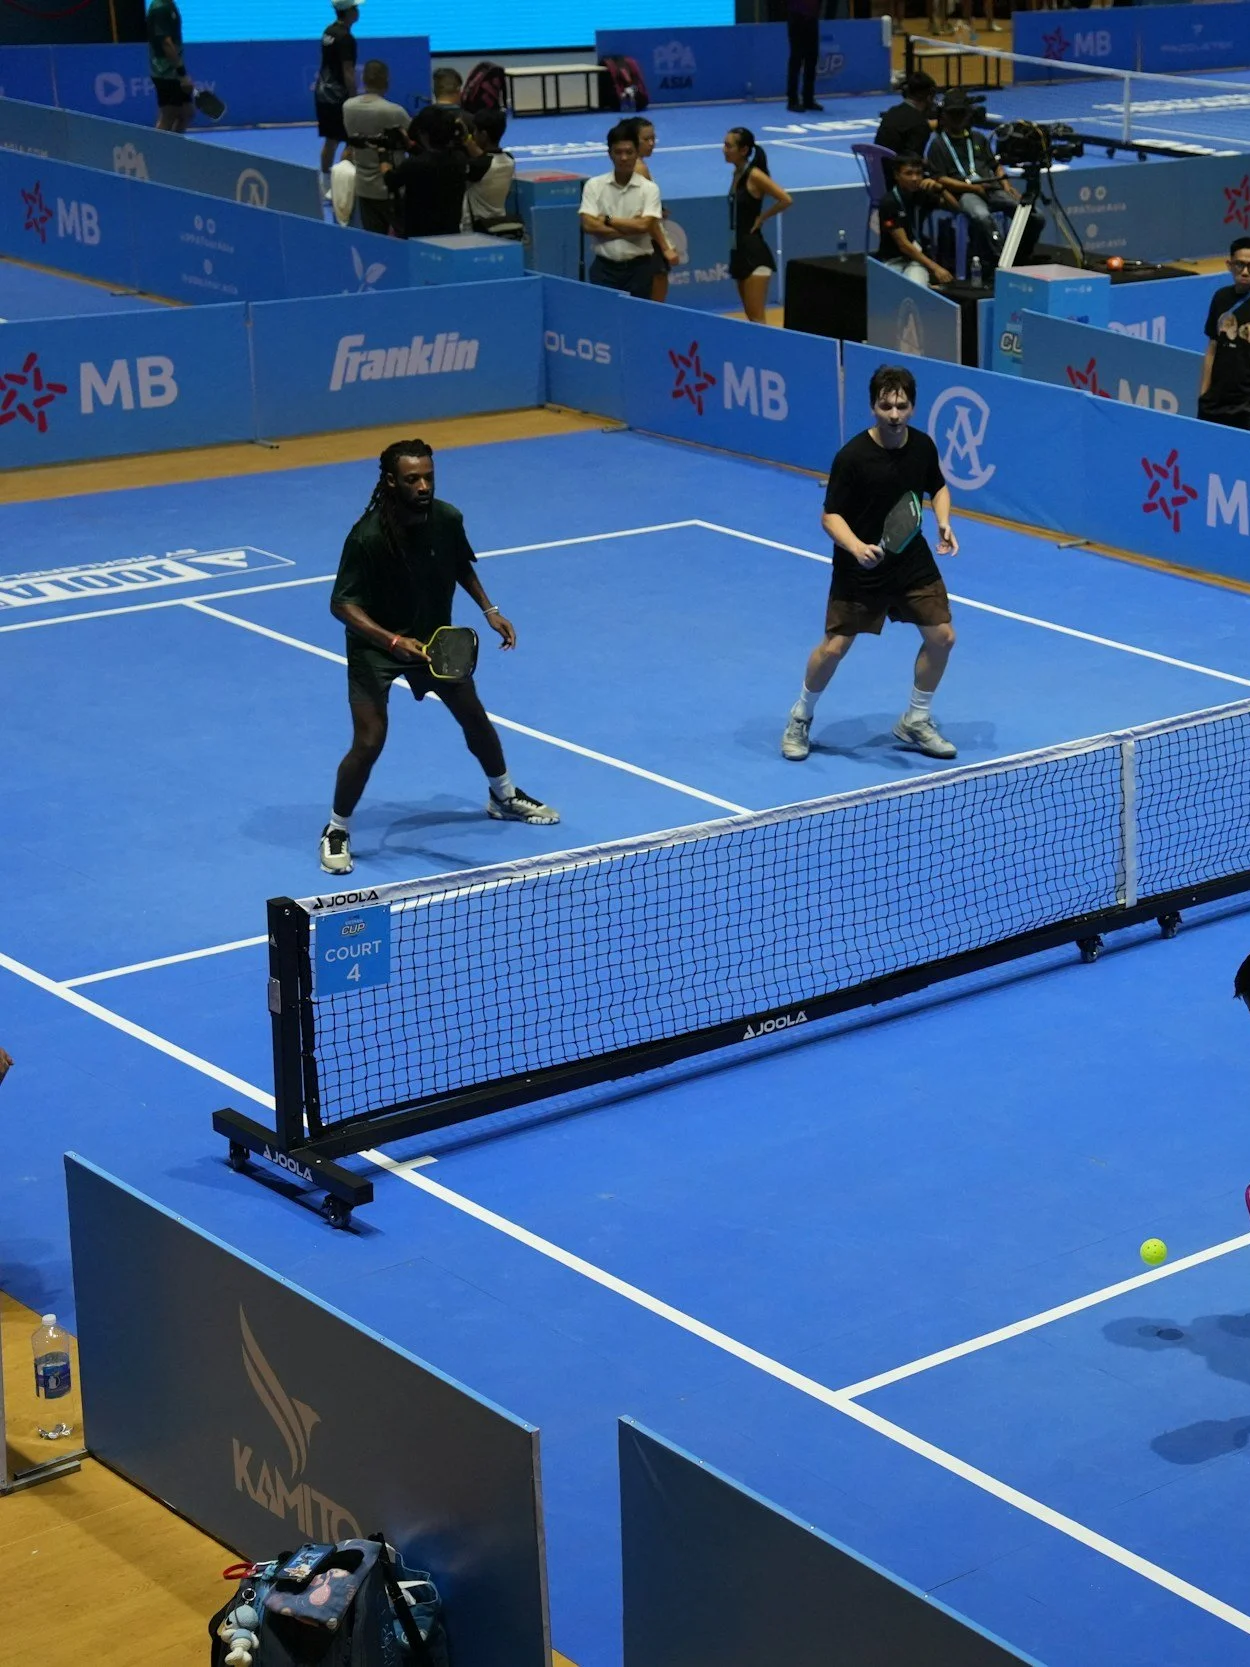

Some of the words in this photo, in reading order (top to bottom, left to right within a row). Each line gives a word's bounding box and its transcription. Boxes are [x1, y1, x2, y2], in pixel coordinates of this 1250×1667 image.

[1074, 31, 1111, 57] MB
[816, 53, 843, 74] UP
[660, 75, 692, 89] ASIA
[57, 198, 100, 244] MB
[544, 330, 611, 365] OLOS
[80, 355, 178, 413] MB
[723, 361, 789, 421] MB
[0, 563, 187, 599] JOOLA
[327, 889, 379, 908] JOOLA
[341, 922, 365, 936] CUP
[325, 940, 382, 962] COURT
[346, 963, 361, 982] 4
[756, 1010, 808, 1036] JOOLA
[271, 1150, 313, 1183] JOOLA
[232, 1437, 363, 1544] KAMITO
